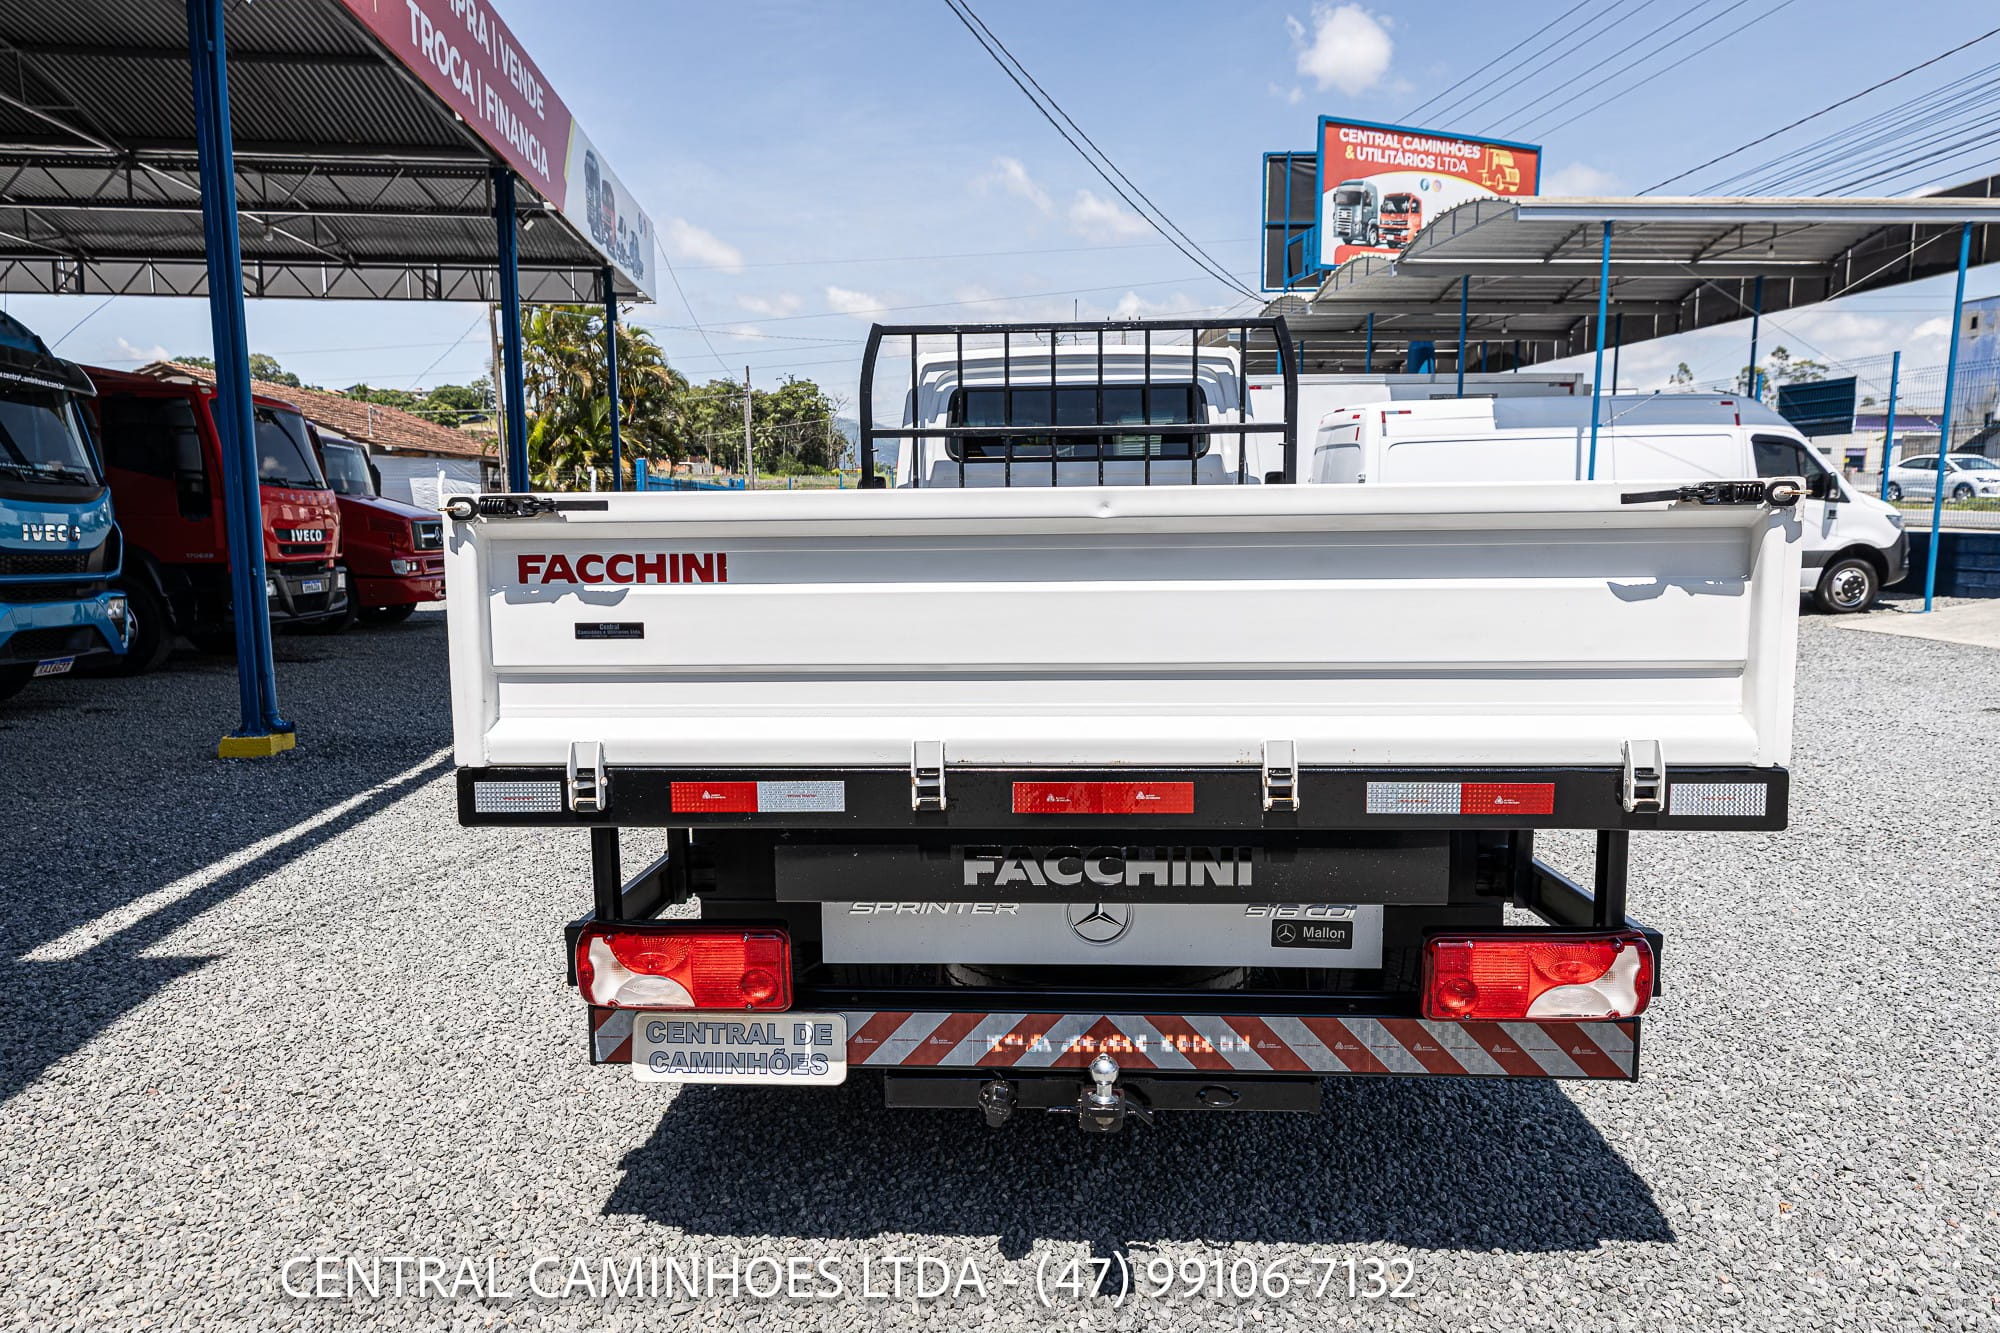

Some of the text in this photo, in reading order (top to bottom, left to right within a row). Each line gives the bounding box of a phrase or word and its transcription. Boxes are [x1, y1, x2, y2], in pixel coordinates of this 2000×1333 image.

[499, 34, 545, 121] VENDE
[406, 0, 476, 107] TROCA
[485, 83, 551, 183] FINANCIA
[1339, 128, 1481, 160] CENTRAL CAMINHÕES
[1345, 145, 1469, 174] & UTILITÁRIOS LTDA
[22, 523, 81, 542] IVECO
[290, 529, 323, 542] IVECO
[517, 552, 728, 585] FACCHINI
[963, 846, 1252, 887] FACCHINI
[848, 902, 1021, 916] SPRINTER
[1245, 903, 1358, 919] 516 CDI
[1303, 926, 1345, 939] Mallon
[645, 1021, 833, 1046] CENTRAL DE
[649, 1048, 829, 1075] CAMINHÕES
